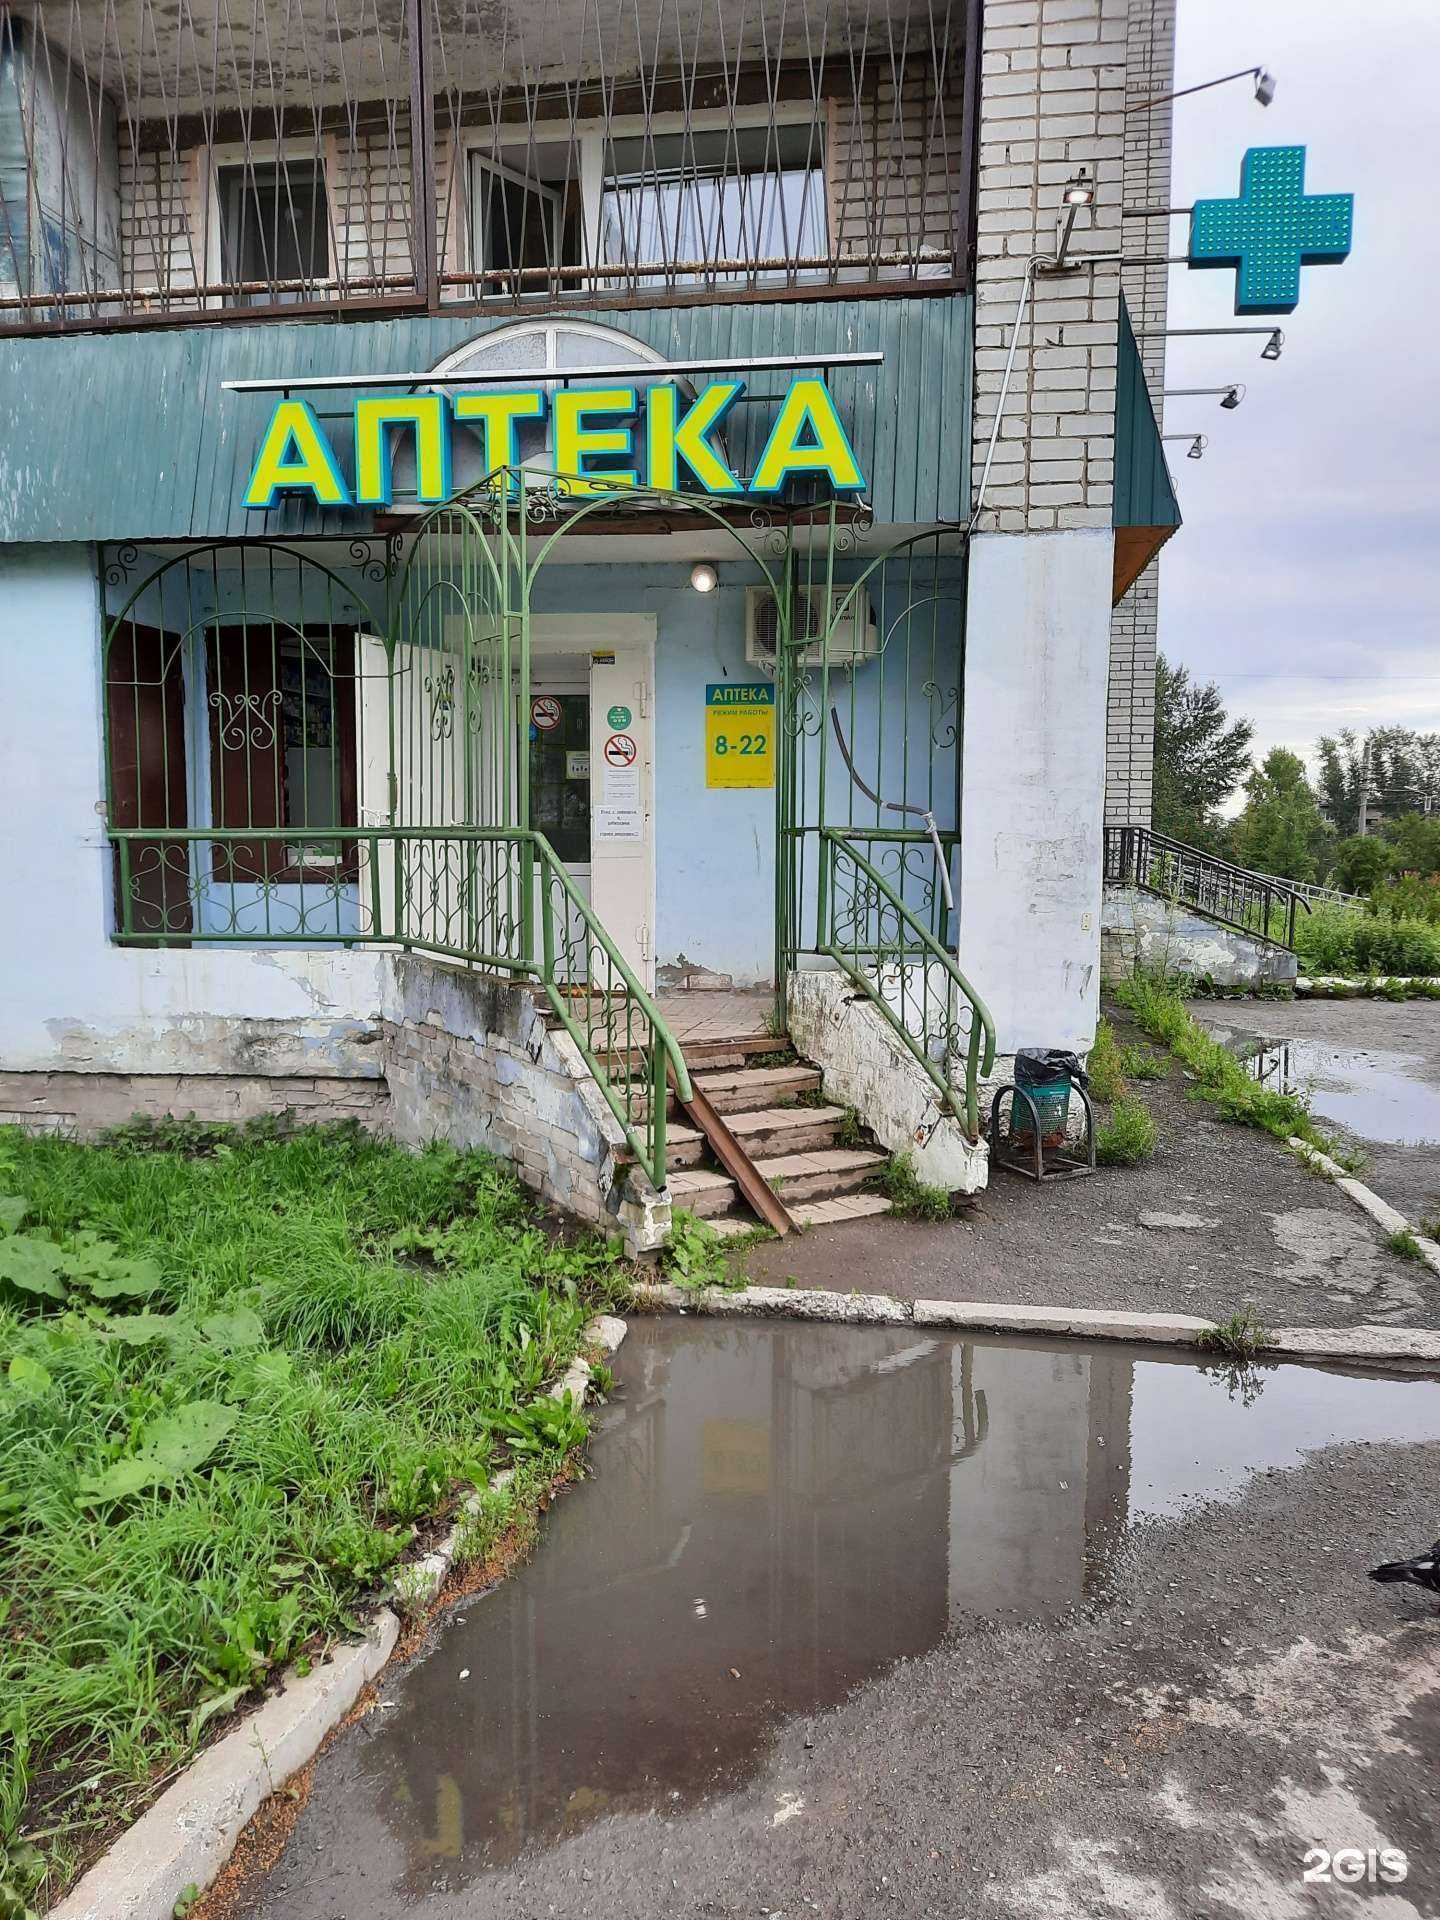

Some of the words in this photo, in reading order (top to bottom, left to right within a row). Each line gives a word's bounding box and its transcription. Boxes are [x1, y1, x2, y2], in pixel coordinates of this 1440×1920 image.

[242, 376, 866, 509] АПТЕКА
[712, 688, 769, 701] АПТЕКА
[715, 735, 767, 755] 8-22
